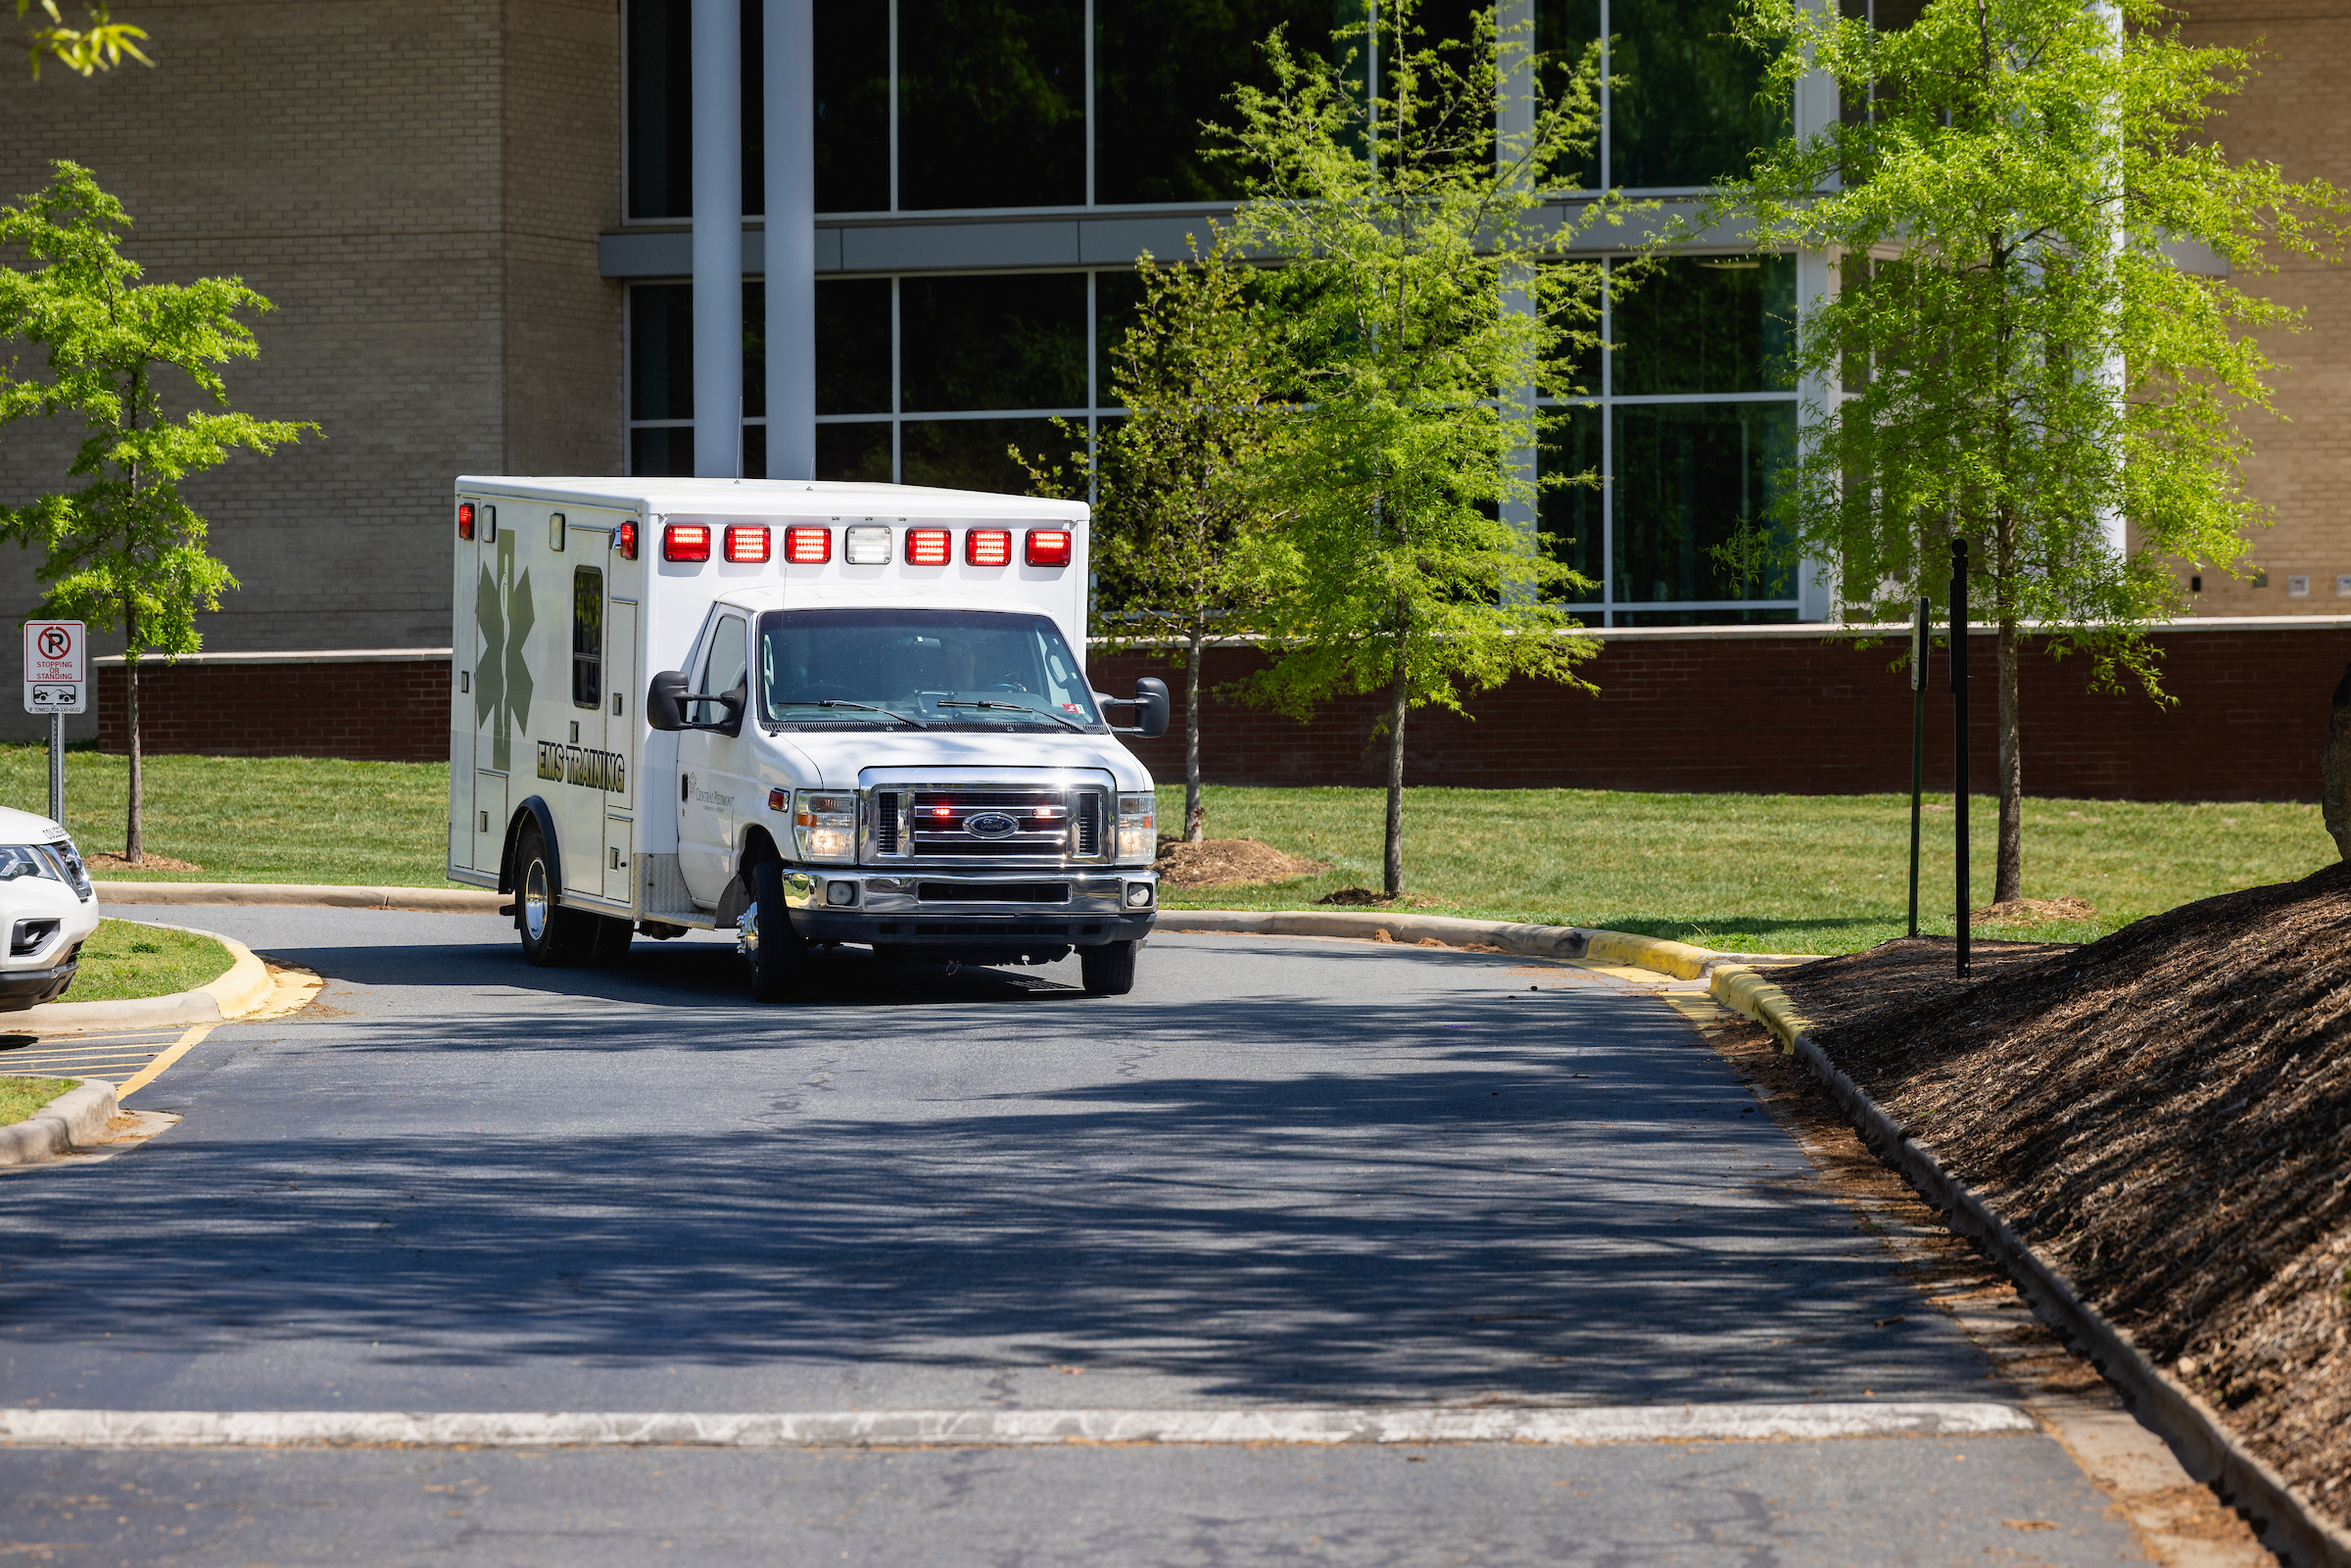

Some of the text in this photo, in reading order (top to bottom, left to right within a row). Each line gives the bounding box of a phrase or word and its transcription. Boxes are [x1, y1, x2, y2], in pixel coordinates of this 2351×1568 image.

[538, 739, 625, 794] EMS TRAINING
[981, 818, 1005, 830] Ford
